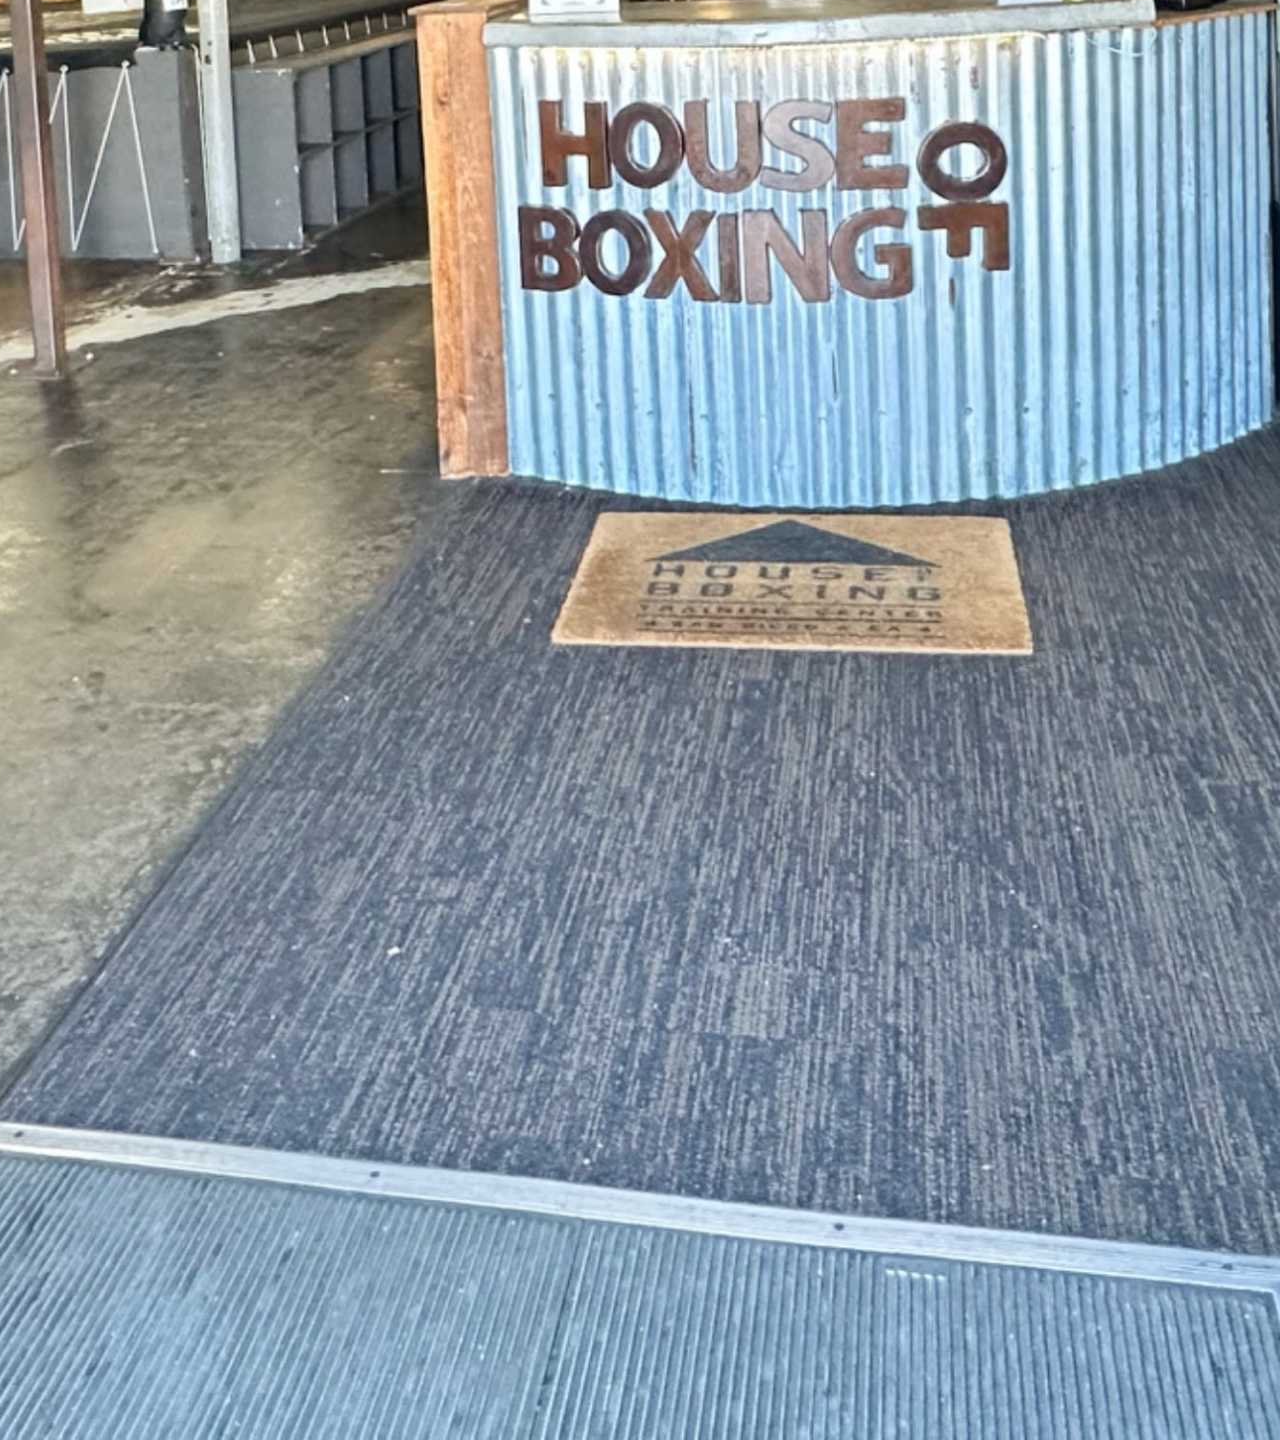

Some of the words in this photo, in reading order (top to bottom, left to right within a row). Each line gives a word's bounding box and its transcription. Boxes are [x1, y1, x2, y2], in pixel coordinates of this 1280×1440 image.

[538, 97, 909, 193] HOUSE
[518, 205, 915, 305] BOXING
[652, 563, 898, 582] HOUSE
[646, 582, 942, 601] BOXING
[639, 604, 791, 616] TRAINING
[815, 607, 942, 619] CENTER
